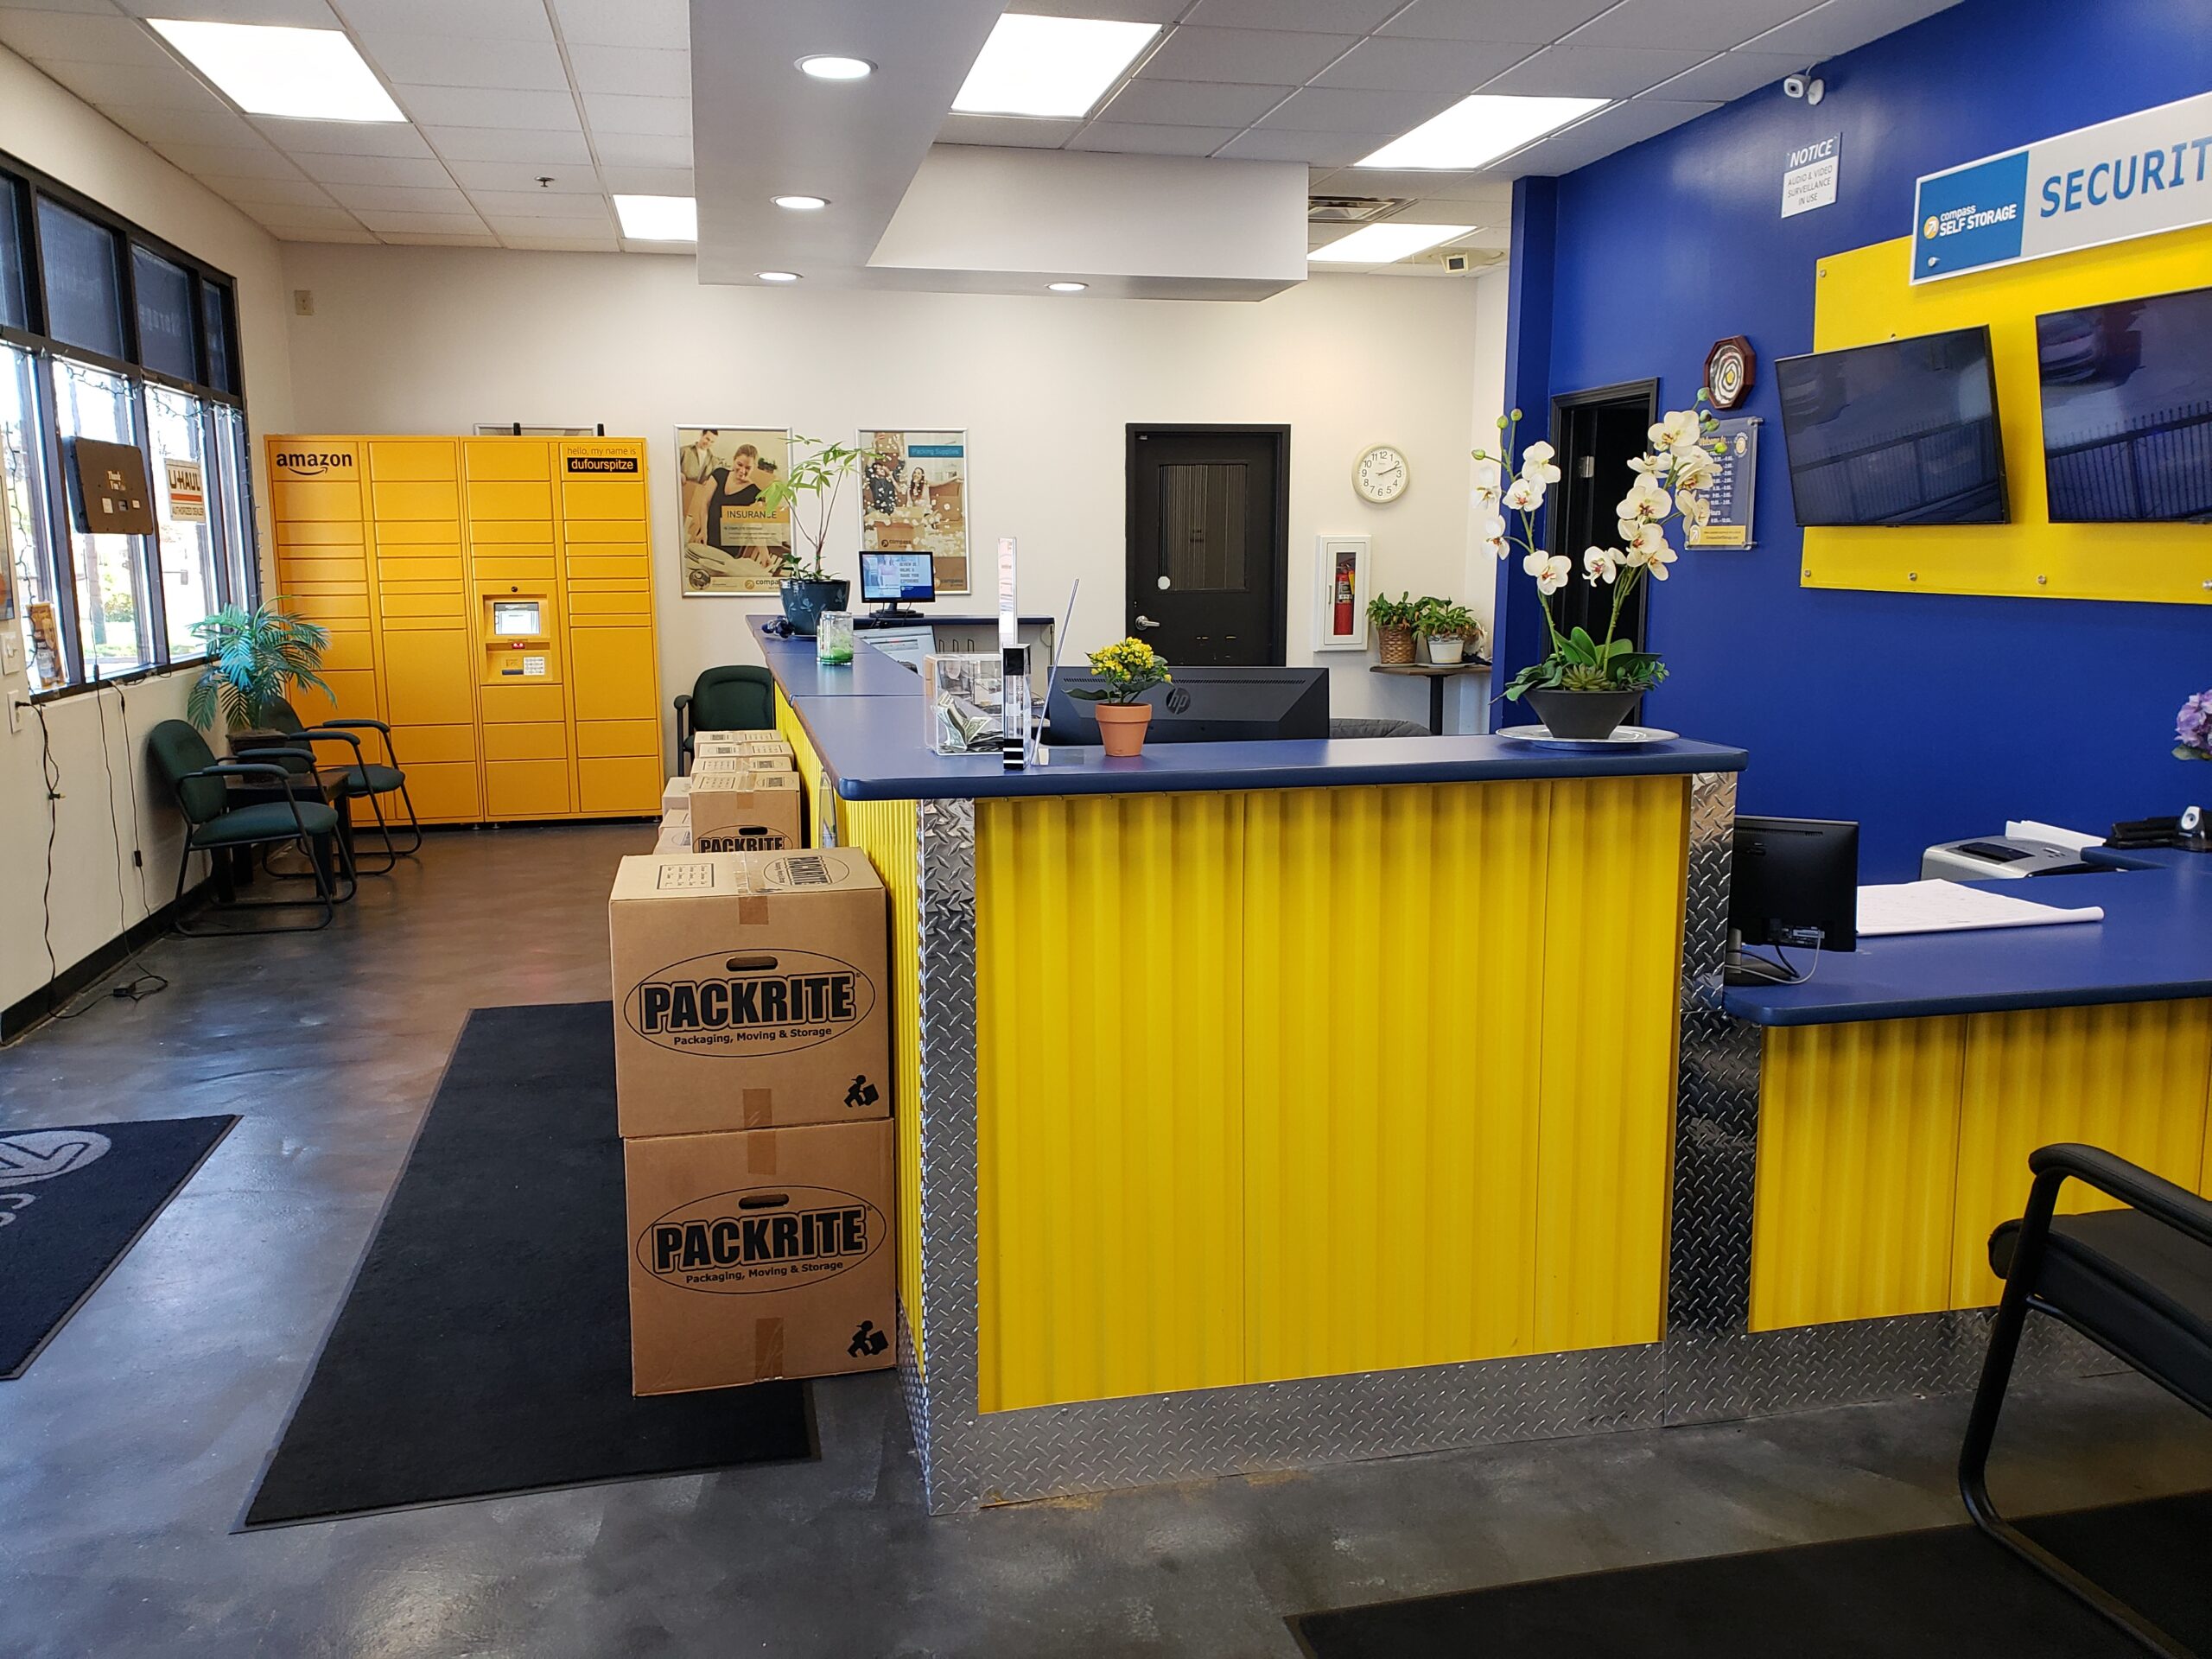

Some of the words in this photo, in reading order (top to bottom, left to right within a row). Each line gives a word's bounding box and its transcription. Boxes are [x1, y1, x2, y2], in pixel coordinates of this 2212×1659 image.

[1790, 139, 1834, 168] NOTICE
[1788, 174, 1808, 187] AUDIO
[1808, 171, 1813, 180] &
[1814, 165, 1833, 178] VIDEO
[2040, 136, 2212, 218] SECURIT
[1788, 177, 1832, 198] SURVEILLANCE
[1798, 197, 1805, 206] IN
[1807, 193, 1818, 203] USE
[1939, 218, 1967, 237] SELF
[1967, 204, 2018, 230] STORAGE
[1940, 205, 1976, 222] compass
[567, 447, 589, 455] hello,
[1371, 453, 1378, 461] 11
[276, 453, 353, 467] amazon
[571, 459, 634, 472] dufourspitze
[1363, 460, 1372, 468] 10
[168, 469, 201, 492] U-HAUL
[1363, 478, 1370, 486] 8
[1395, 469, 1402, 478] 3
[1370, 485, 1376, 493] 7
[727, 510, 777, 518] INSURANE
[1167, 688, 1189, 715] hp
[700, 836, 784, 853] PACKRITE
[644, 976, 854, 1030] PACKRITE
[673, 1033, 734, 1046] Packaging,
[736, 1030, 776, 1043] Moving
[779, 1029, 788, 1039] &
[791, 1027, 832, 1039] Storage
[657, 1209, 865, 1270] PACKRITE
[686, 1271, 746, 1284] Packaging,
[748, 1267, 787, 1278] Moving
[790, 1264, 799, 1274] &
[801, 1262, 843, 1273] Storage
